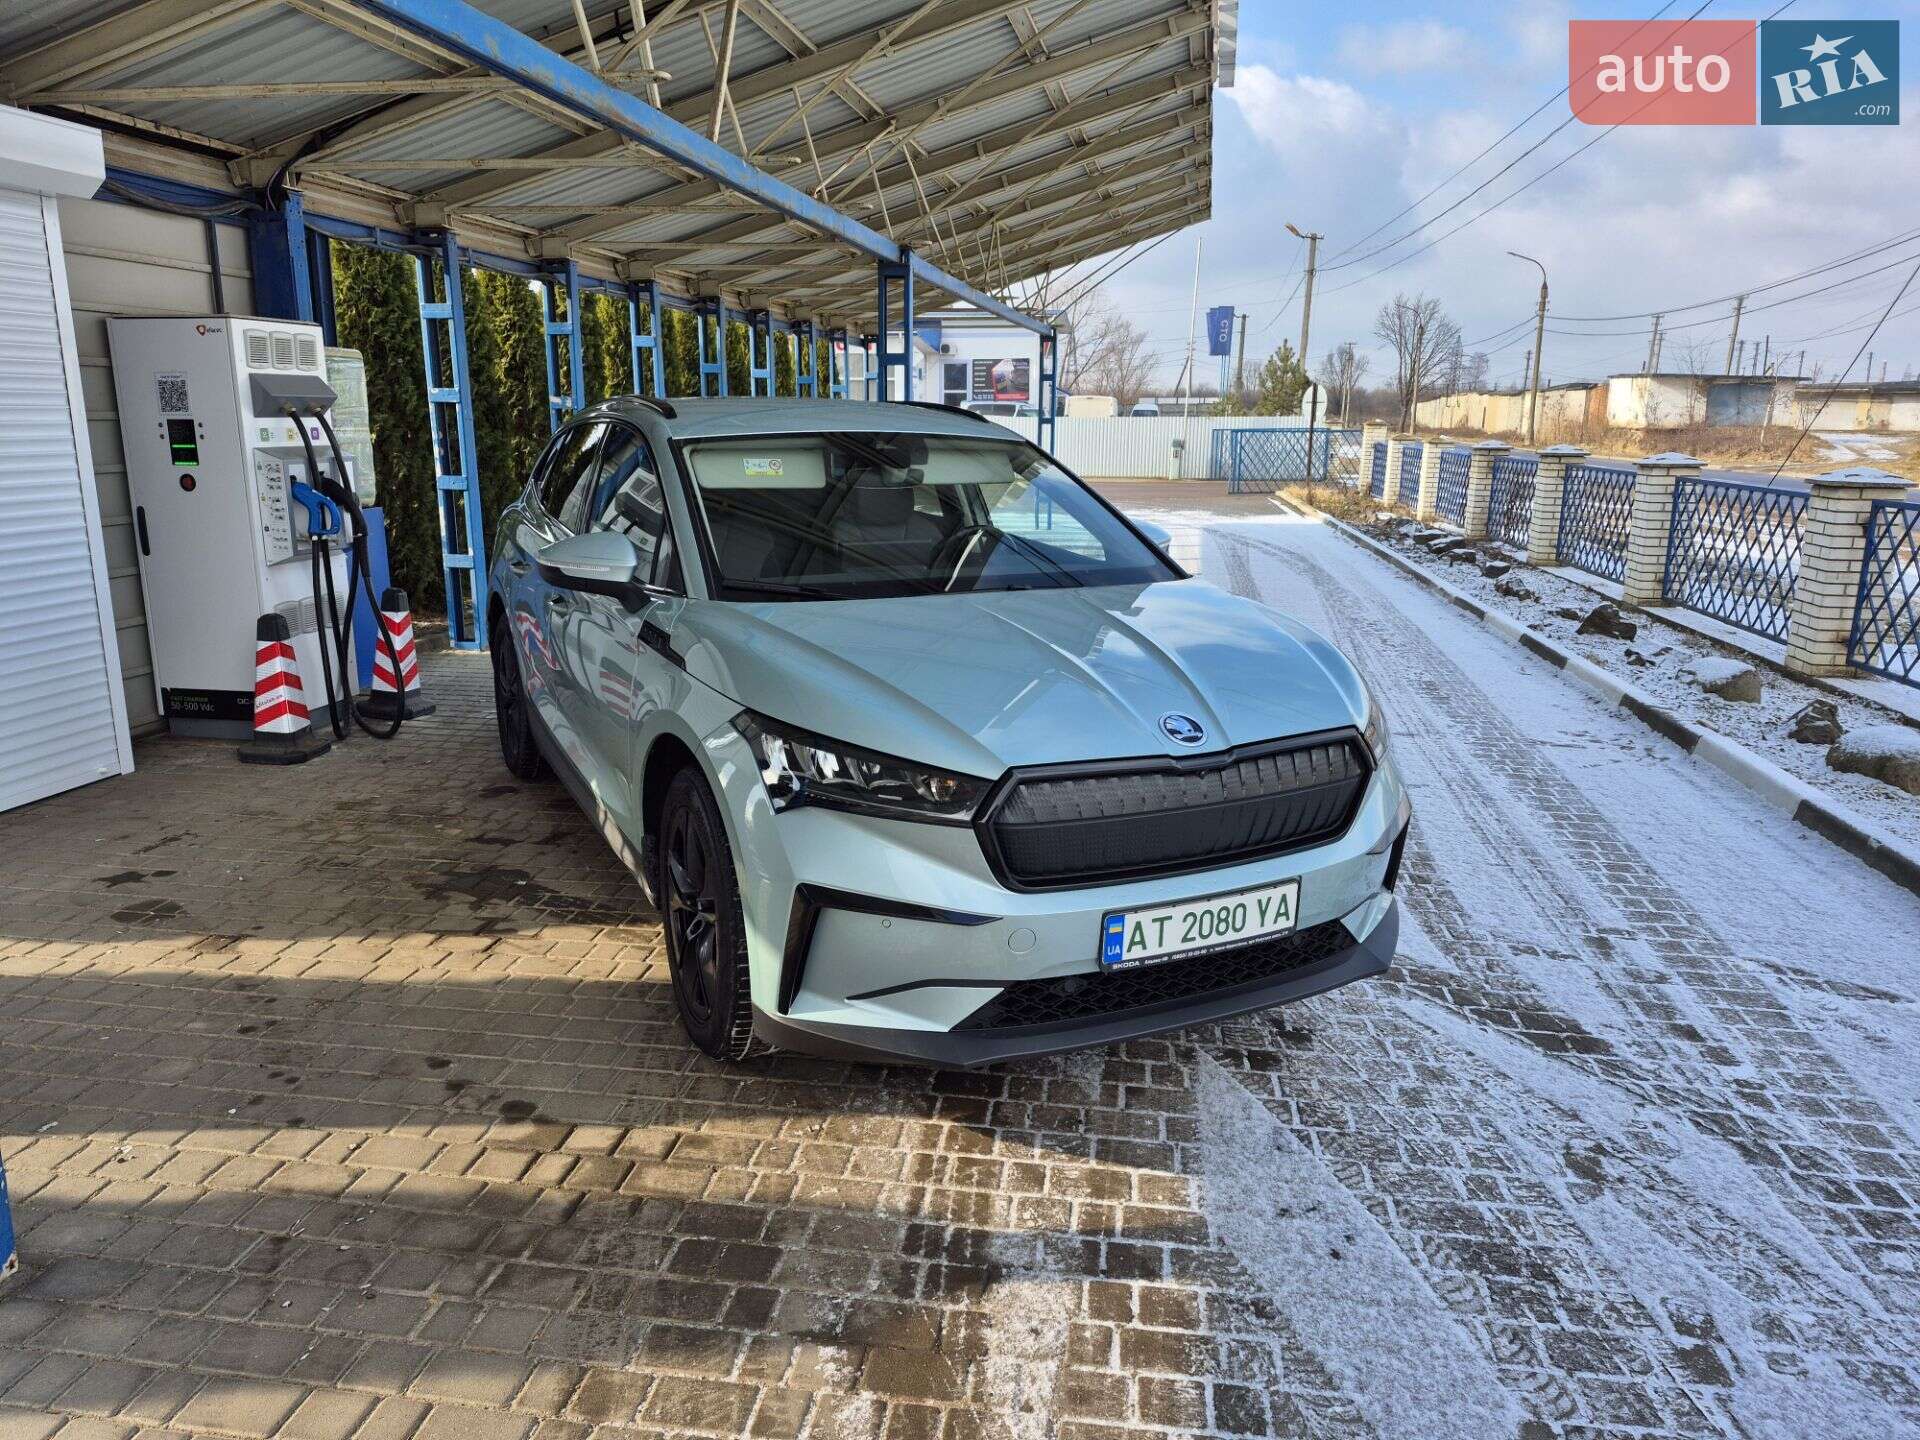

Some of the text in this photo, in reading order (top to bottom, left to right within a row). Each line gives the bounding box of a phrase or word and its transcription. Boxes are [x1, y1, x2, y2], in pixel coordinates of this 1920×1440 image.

[1126, 893, 1290, 953] AT 2080 YA
[1107, 945, 1121, 956] UA
